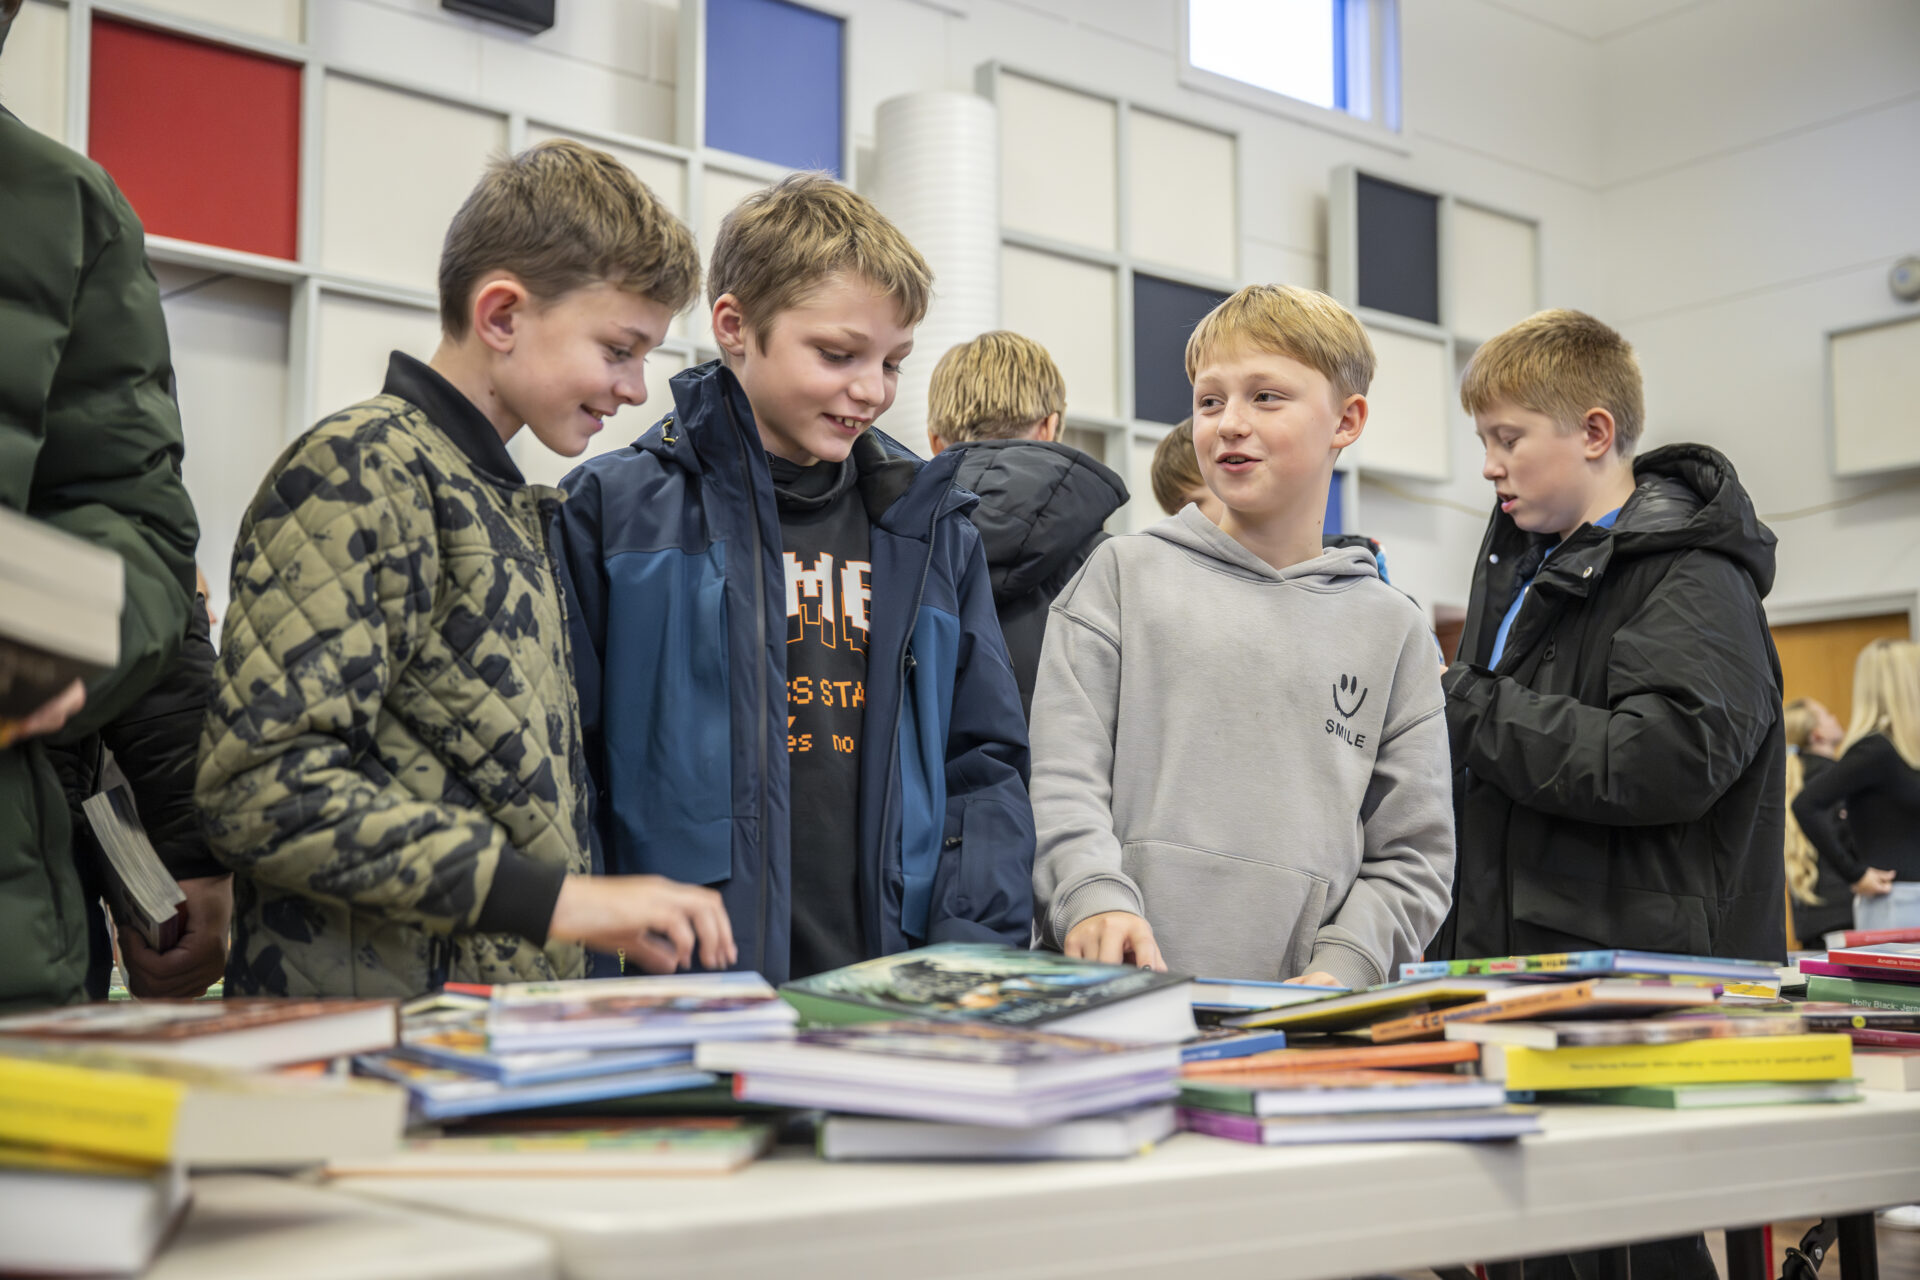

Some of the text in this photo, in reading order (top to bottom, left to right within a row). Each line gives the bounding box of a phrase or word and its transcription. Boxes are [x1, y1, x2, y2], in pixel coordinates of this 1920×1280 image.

[787, 676, 813, 704] S
[832, 734, 854, 753] no
[1325, 719, 1366, 748] SMILE
[1851, 998, 1872, 1009] Holly
[1901, 1003, 1920, 1013] Jern
